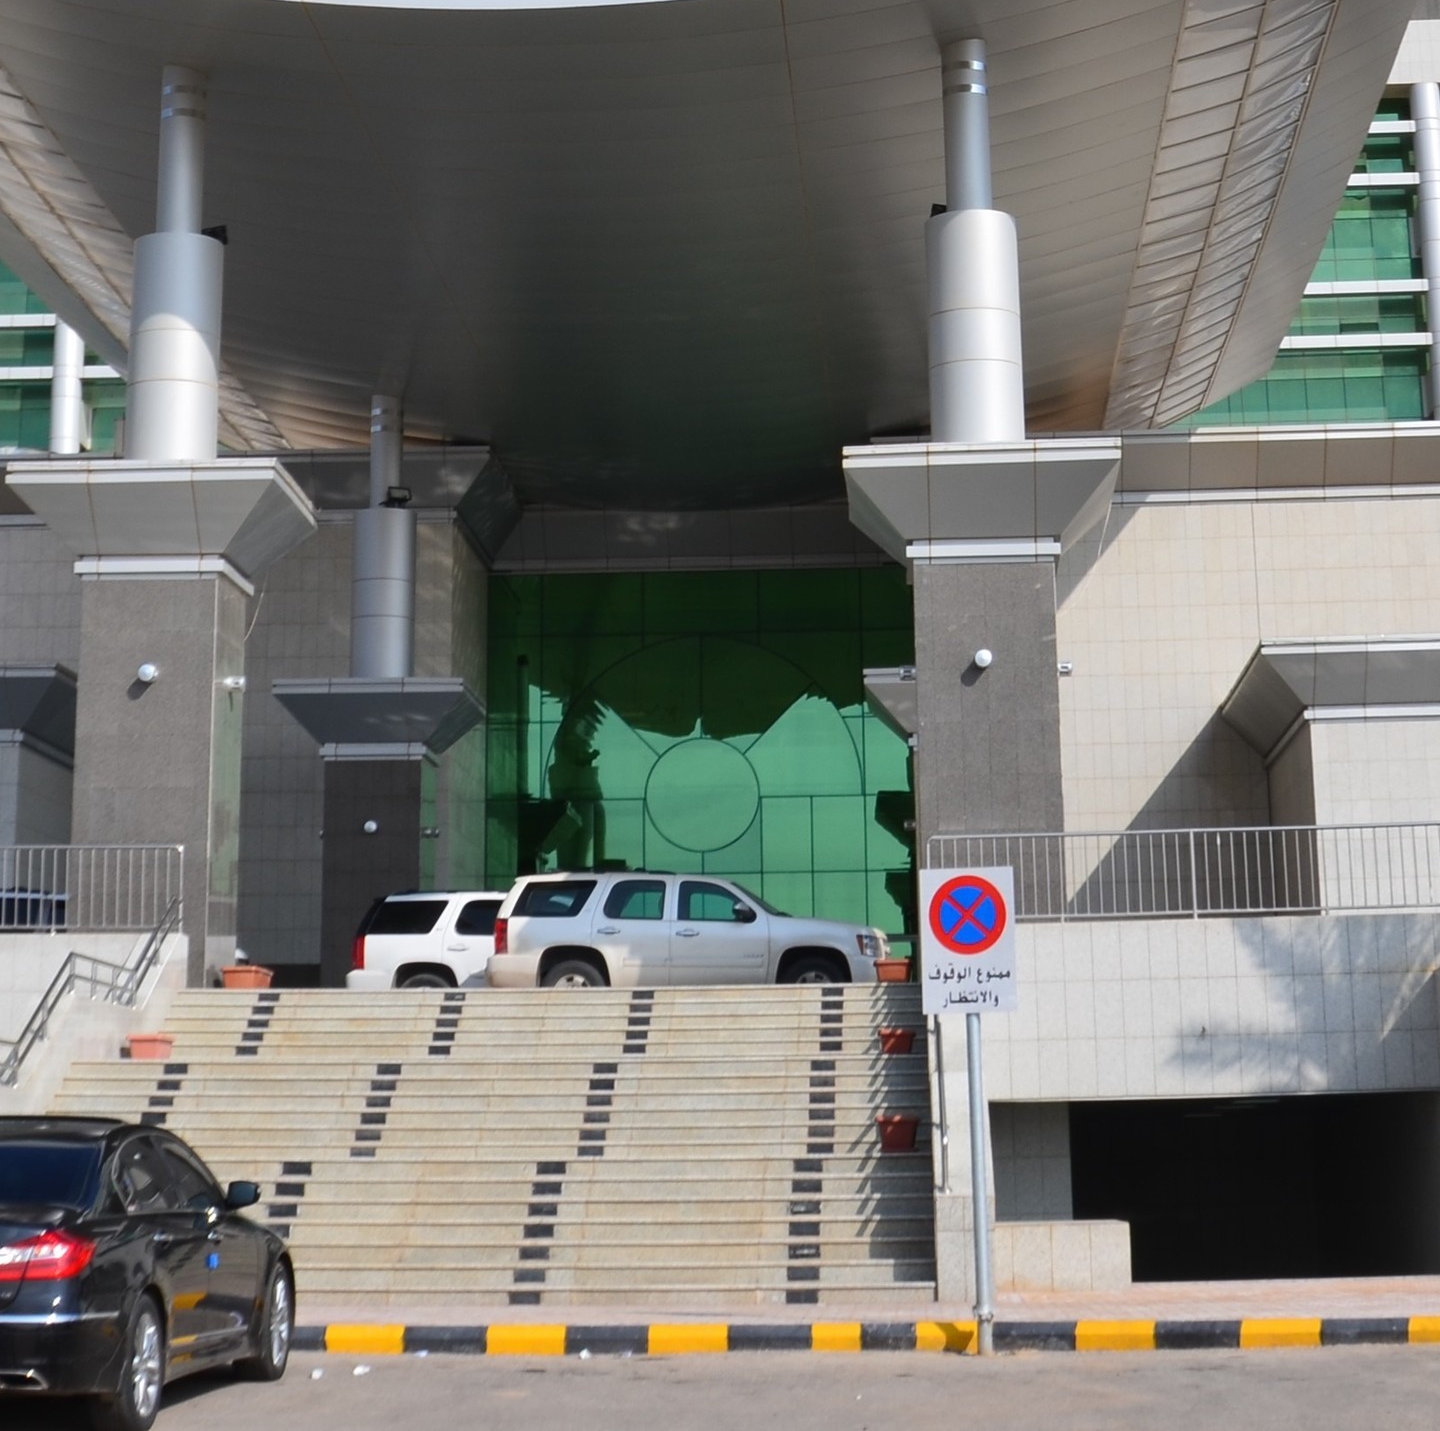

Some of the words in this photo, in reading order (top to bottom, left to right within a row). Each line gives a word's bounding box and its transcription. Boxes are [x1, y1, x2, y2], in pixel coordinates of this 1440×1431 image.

[928, 963, 972, 984] الوقوف
[976, 967, 1011, 984] ممنوع
[943, 990, 999, 1008] والانتظار
